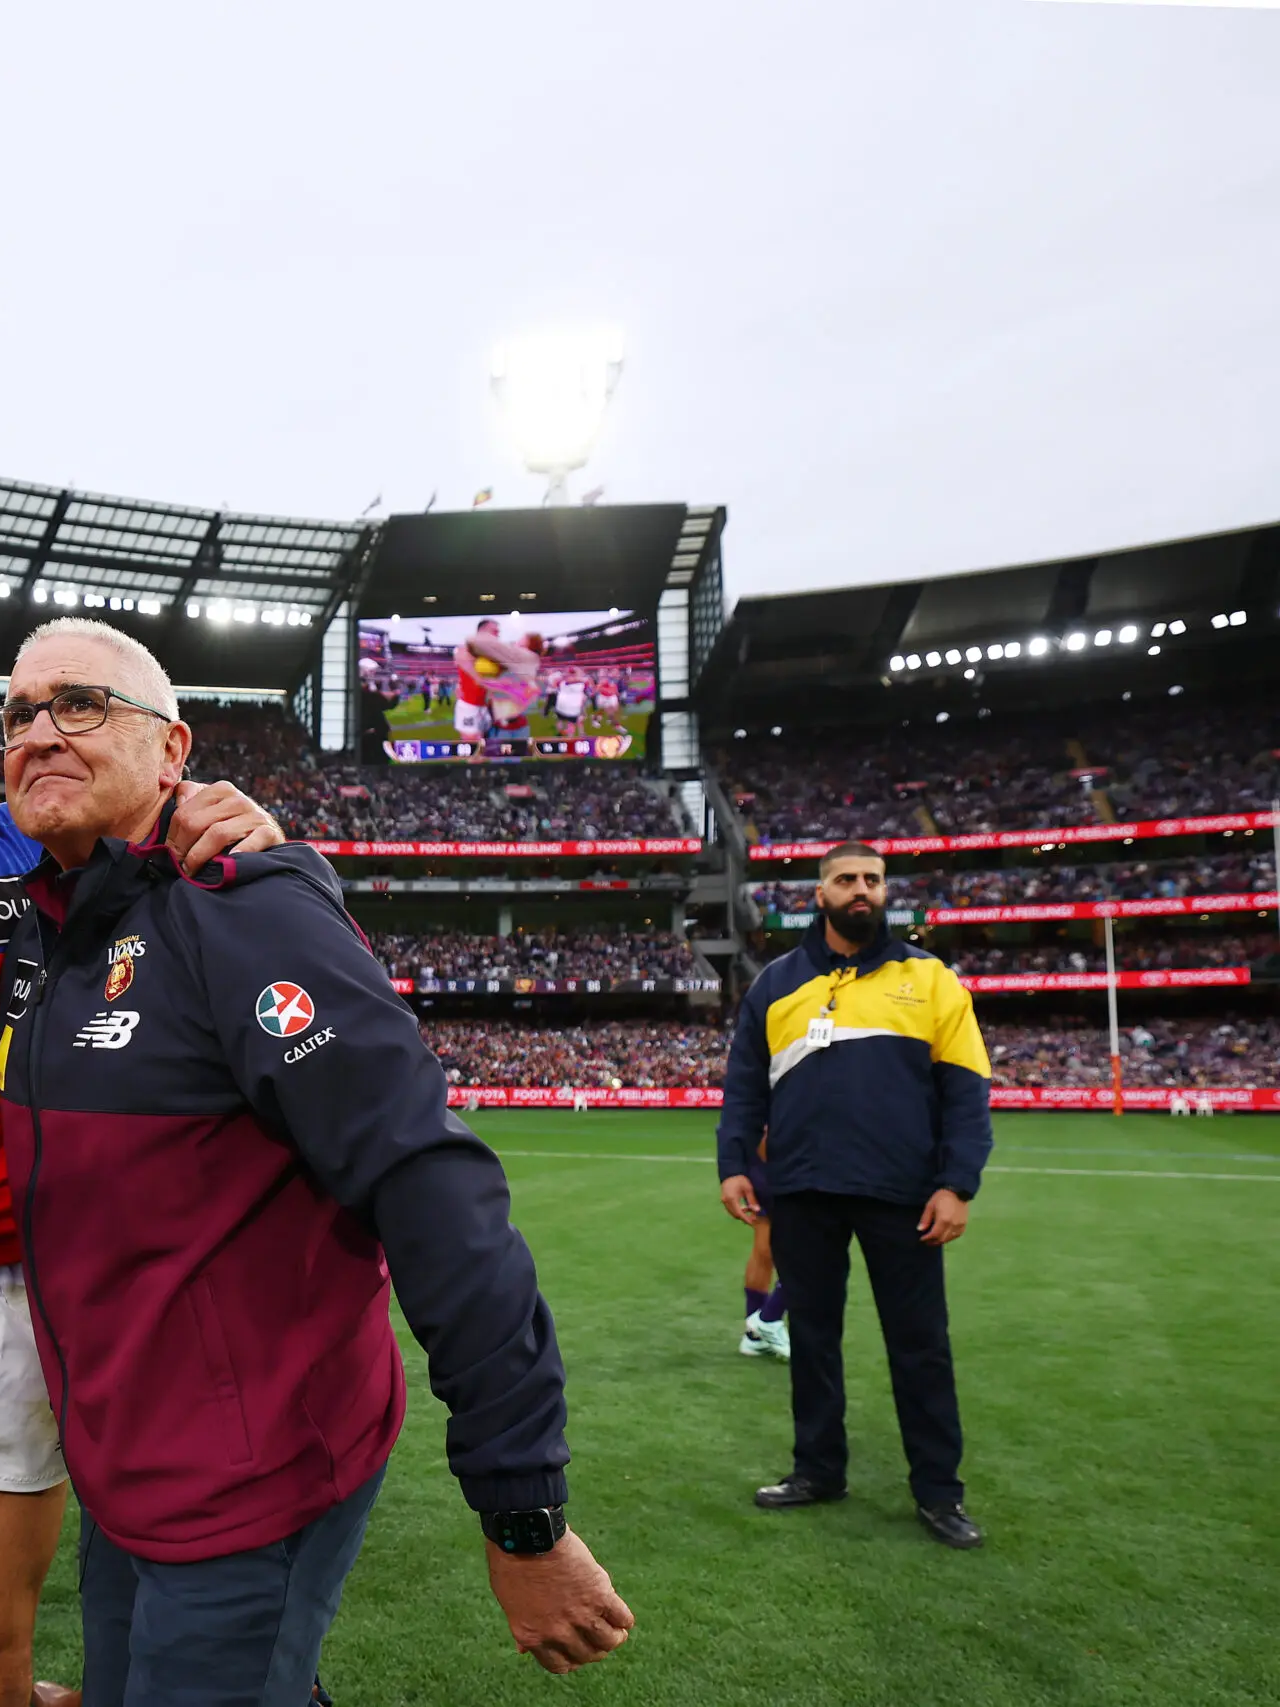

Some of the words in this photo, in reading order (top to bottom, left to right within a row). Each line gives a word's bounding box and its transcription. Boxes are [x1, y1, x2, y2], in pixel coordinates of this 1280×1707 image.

[1185, 815, 1249, 832] TOYOTA
[371, 843, 415, 855] TOYOTA
[459, 843, 476, 855] OH
[477, 843, 506, 855] WHAT
[507, 844, 517, 854] A
[518, 843, 562, 855] FEELING!
[596, 841, 641, 852] TOYOTA
[892, 837, 945, 852] TOYOTA
[1122, 900, 1186, 914] TOYOTA
[107, 940, 146, 965] LIONS
[1170, 970, 1238, 984] TOYOTA
[284, 1027, 336, 1064] CALTEX
[462, 1089, 507, 1100] TOYOTA
[514, 1089, 554, 1100] FOOTY.
